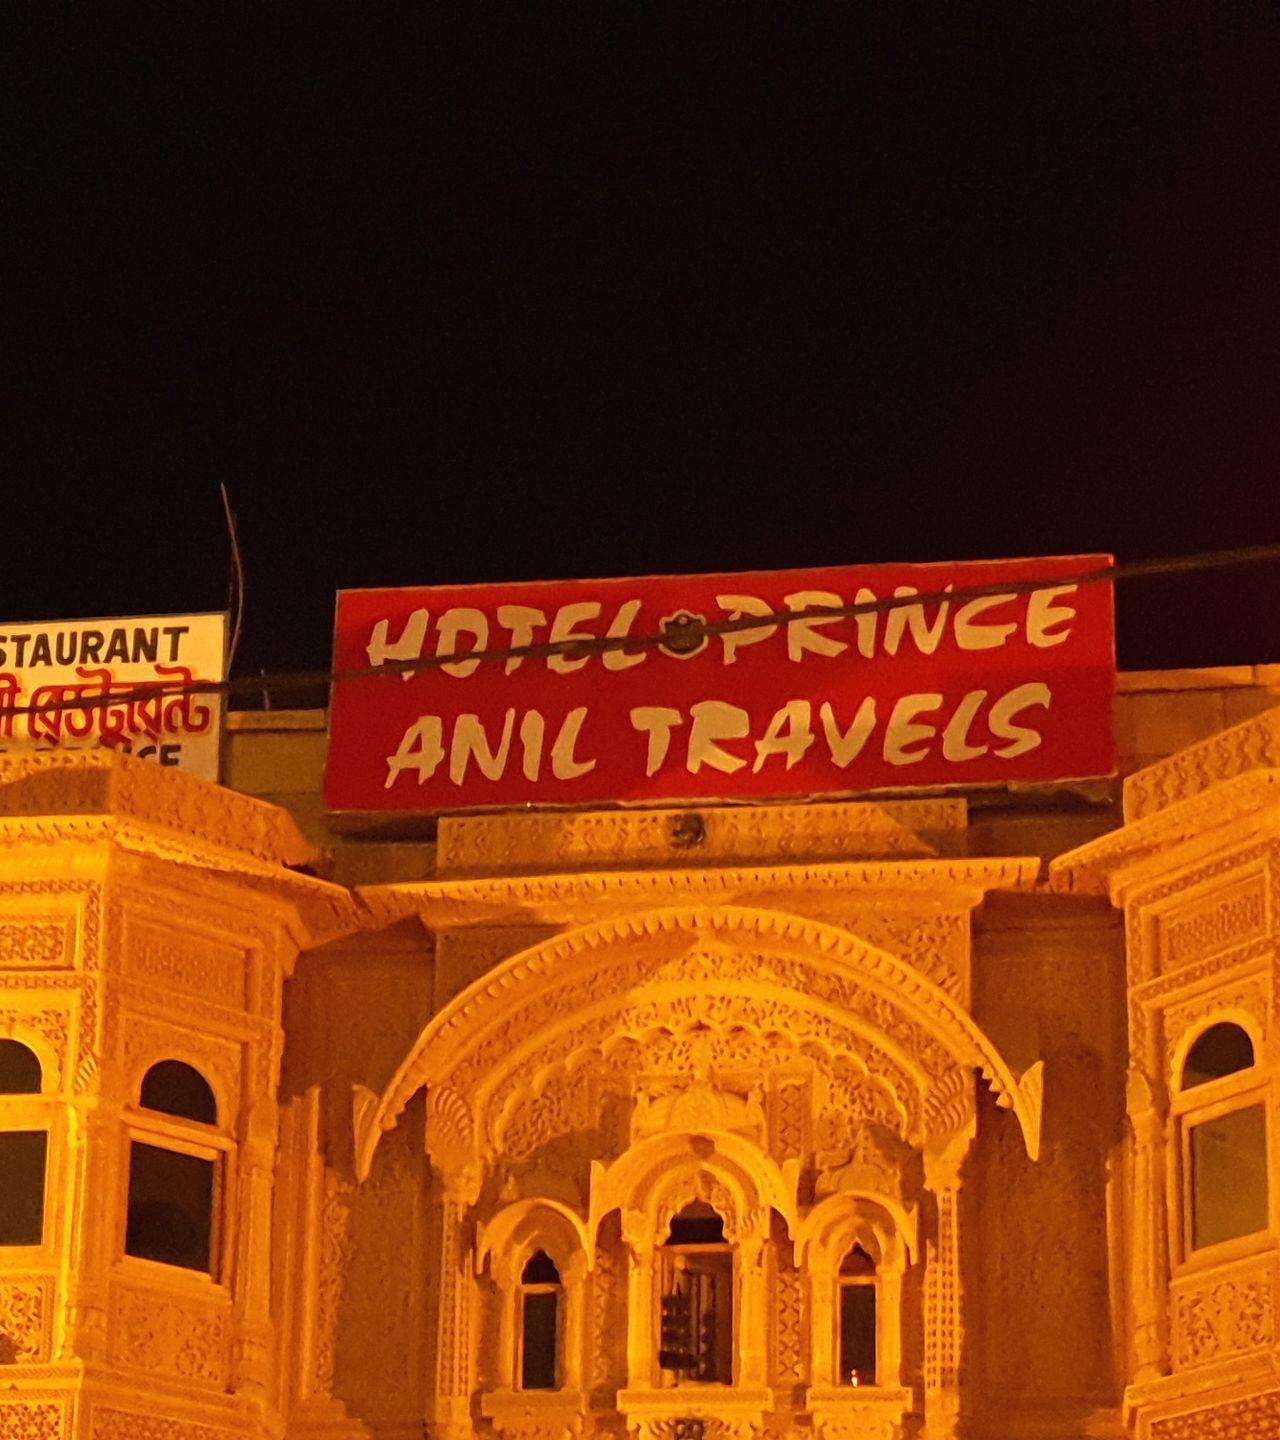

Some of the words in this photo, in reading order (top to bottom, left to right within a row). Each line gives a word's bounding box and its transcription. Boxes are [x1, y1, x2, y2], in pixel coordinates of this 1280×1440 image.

[366, 600, 646, 681] HOTEL
[716, 584, 1077, 665] PRINCE
[385, 706, 597, 788] ANIL
[629, 683, 1051, 778] TRAVELS
